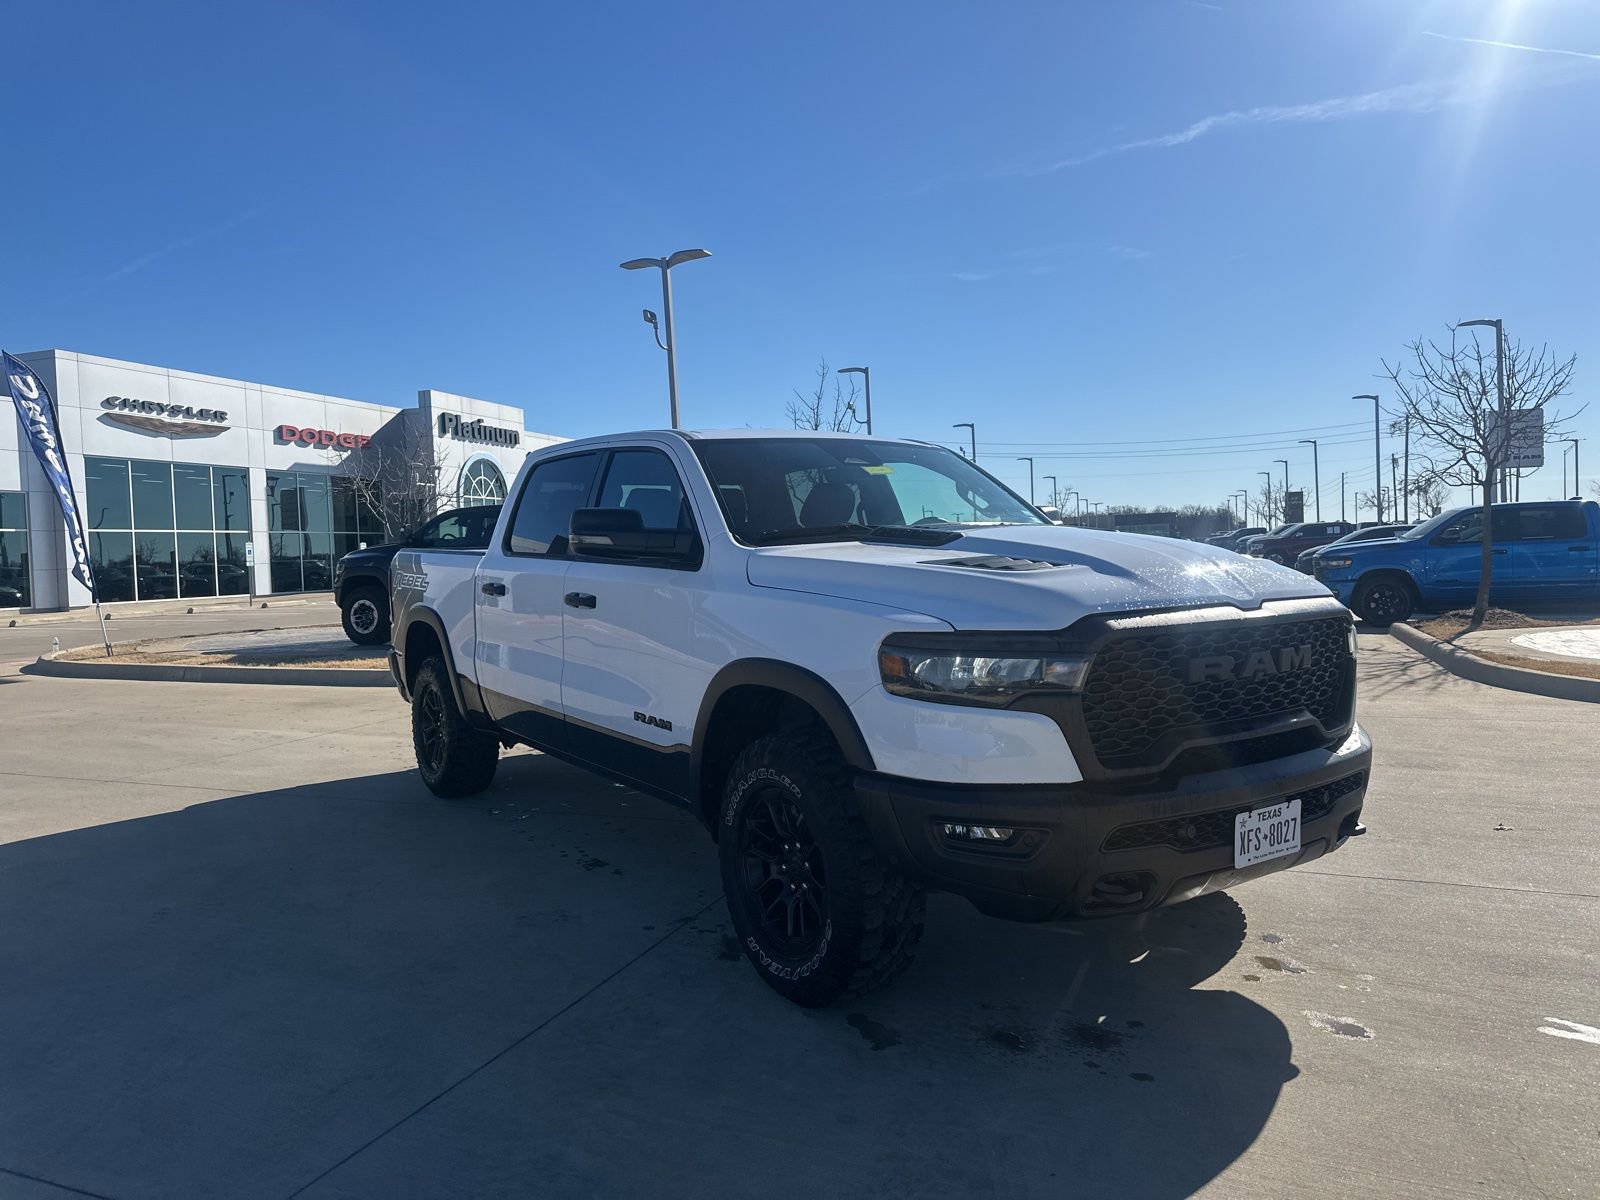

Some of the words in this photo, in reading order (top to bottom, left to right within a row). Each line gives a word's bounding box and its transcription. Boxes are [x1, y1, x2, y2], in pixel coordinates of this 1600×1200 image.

[100, 396, 228, 423] CHRYSLER
[277, 424, 371, 450] DODGE
[440, 412, 520, 447] Platinum
[393, 570, 430, 592] REBEL
[1186, 643, 1312, 684] RAM
[633, 711, 673, 732] RAM
[725, 767, 802, 826] WRANGLER
[1257, 807, 1283, 822] TEXAS
[747, 919, 833, 981] GOODYEAR
